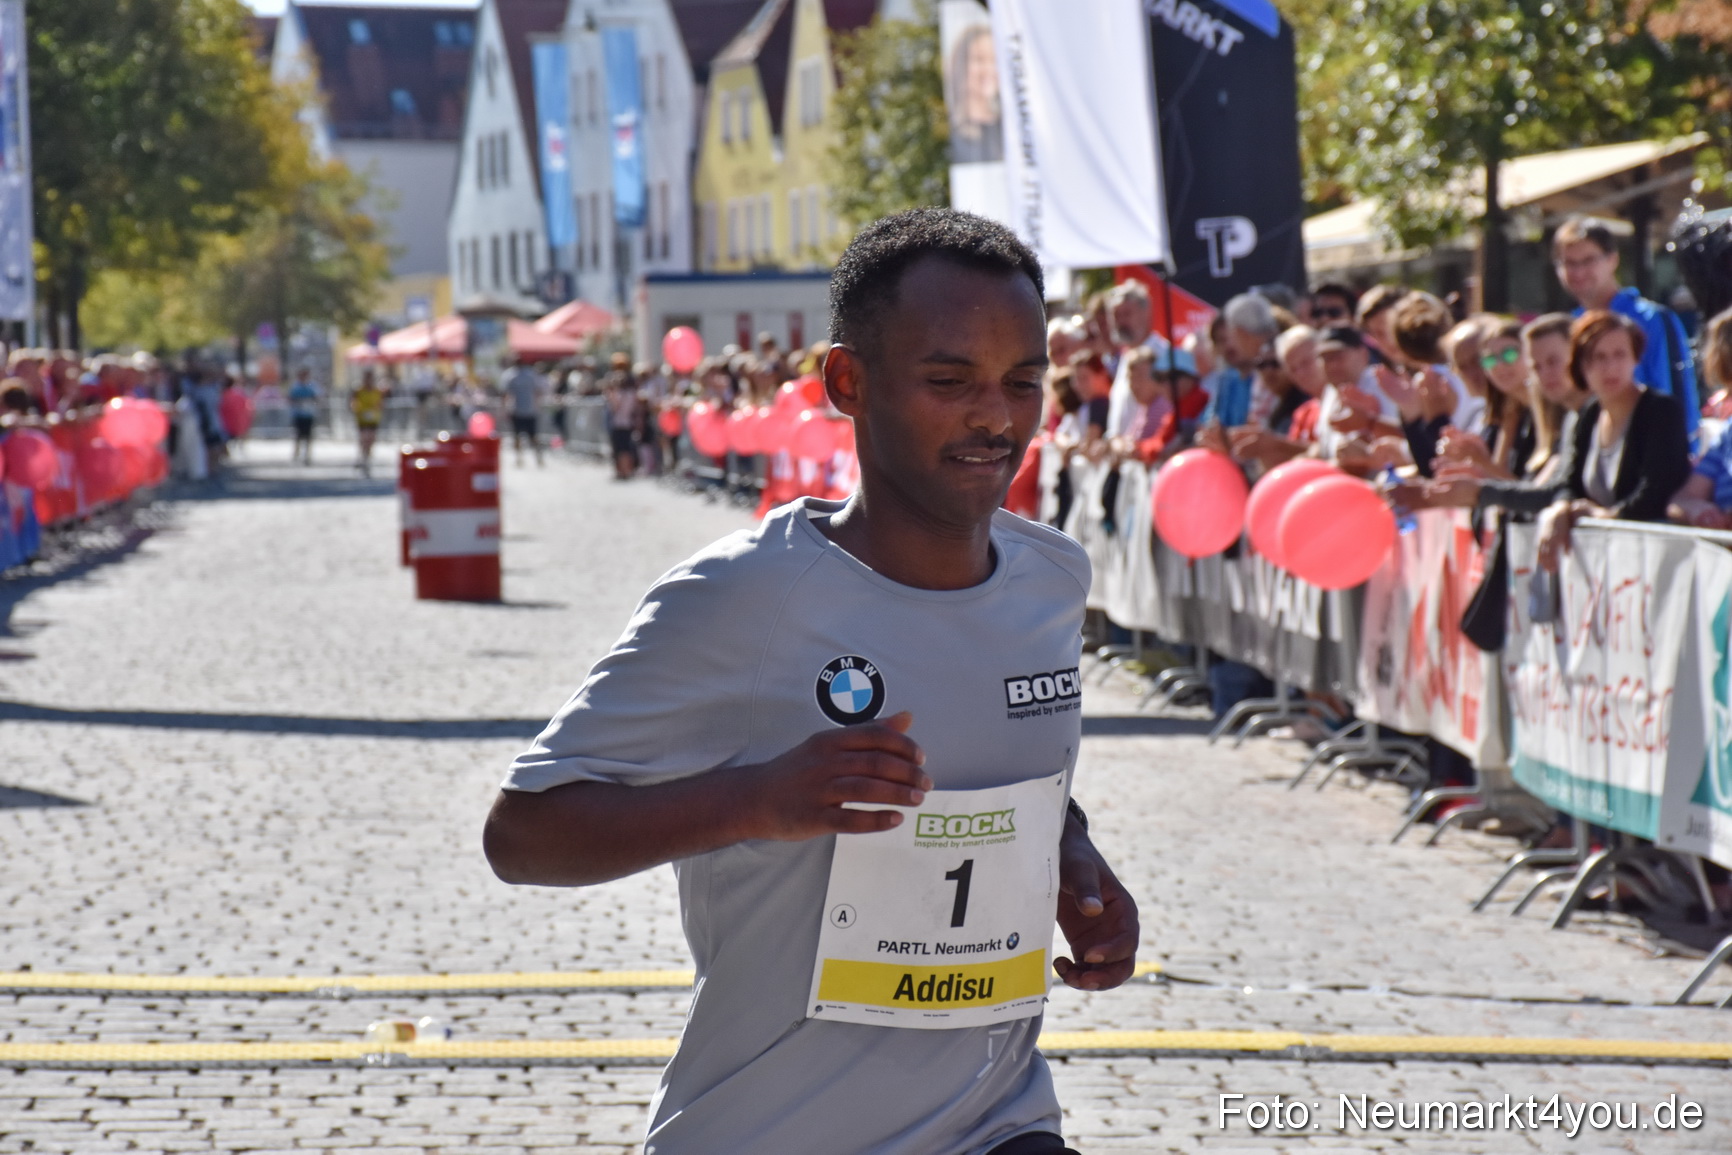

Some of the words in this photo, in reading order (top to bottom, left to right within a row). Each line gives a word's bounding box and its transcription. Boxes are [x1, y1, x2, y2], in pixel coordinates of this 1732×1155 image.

[1143, 0, 1245, 57] ARKT
[819, 657, 878, 685] BMW
[1007, 706, 1042, 721] inspired
[1043, 704, 1053, 717] by
[1054, 702, 1073, 713] smart
[916, 808, 1015, 838] BOCK
[914, 839, 949, 850] inspired
[950, 839, 961, 849] by
[962, 839, 984, 847] smart
[985, 835, 1016, 846] concepts
[944, 859, 975, 929] 1
[837, 910, 849, 923] A
[877, 940, 931, 956] PARTL
[934, 938, 1002, 955] Neumarkt
[894, 973, 993, 1002] Addisu
